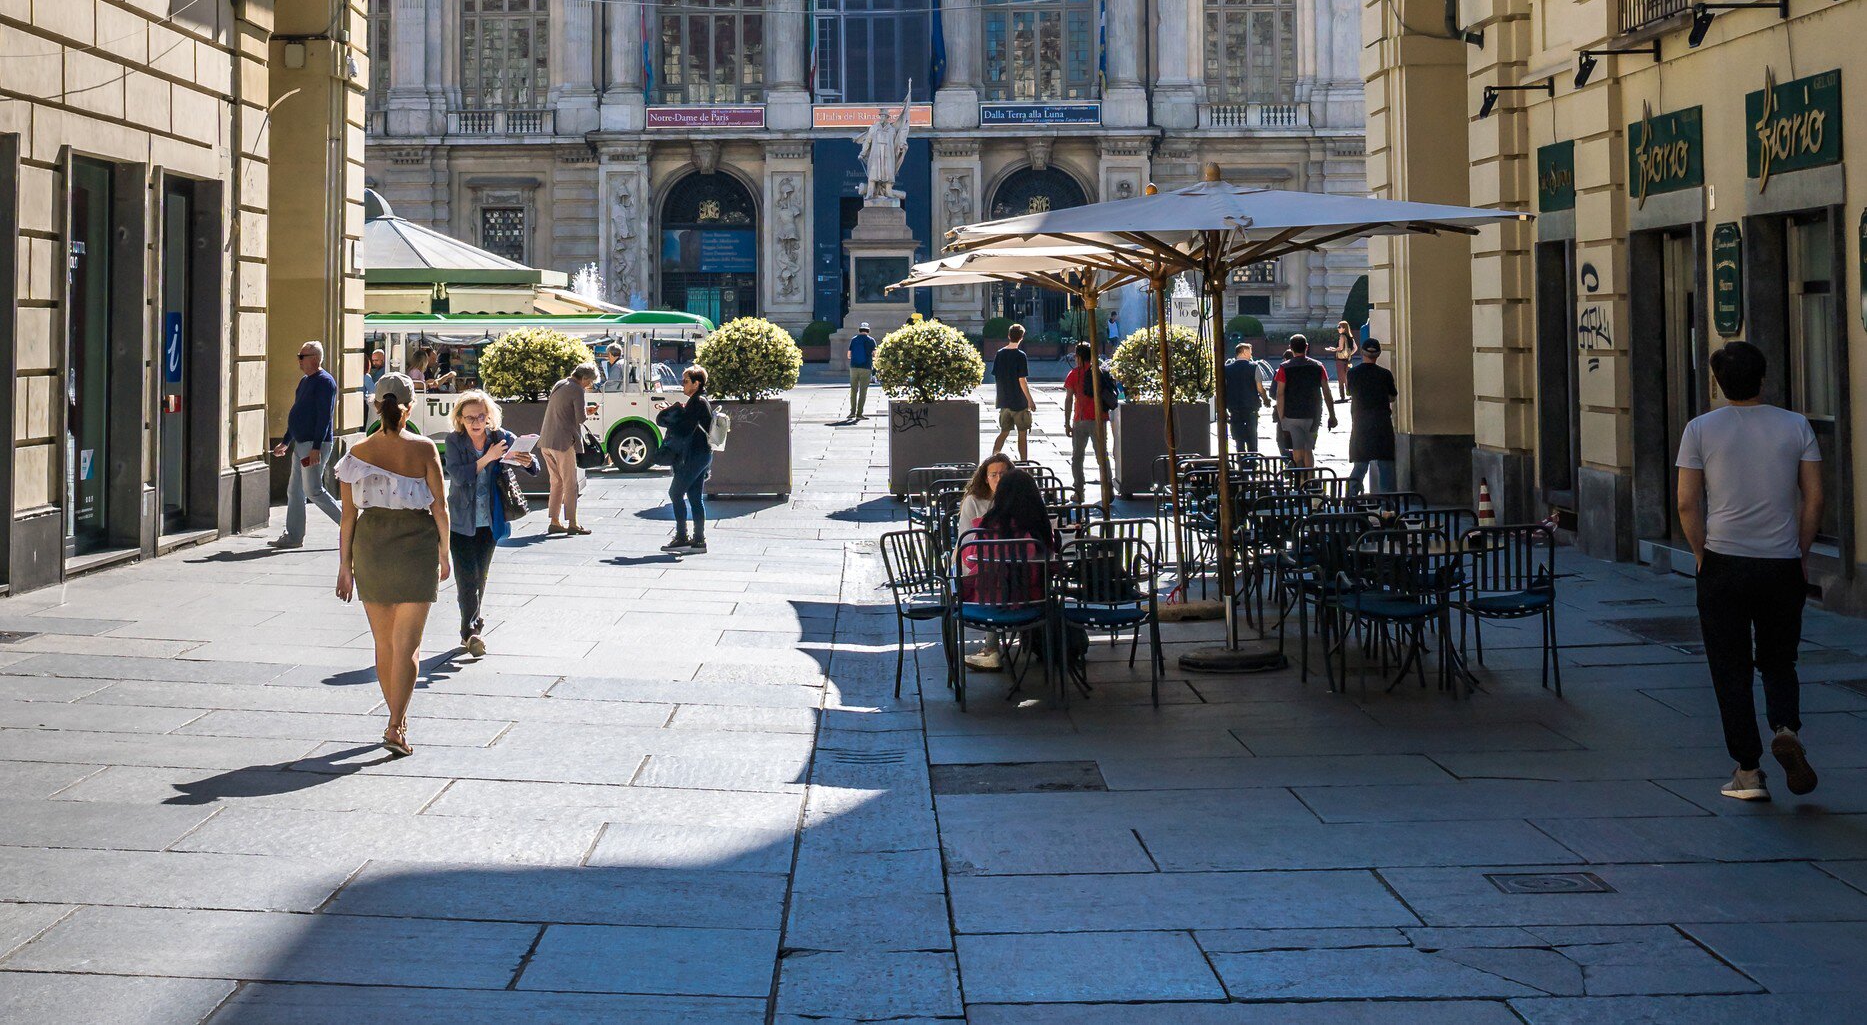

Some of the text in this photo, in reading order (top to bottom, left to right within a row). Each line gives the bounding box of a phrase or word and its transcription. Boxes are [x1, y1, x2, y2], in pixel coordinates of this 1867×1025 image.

[649, 112, 698, 123] Notre-Dame
[699, 112, 709, 122] de
[711, 112, 730, 122] Paris
[843, 112, 855, 121] del
[984, 110, 1005, 119] Dalla
[1006, 110, 1027, 119] Terra
[1028, 109, 1043, 119] alla
[1044, 109, 1065, 119] Luna
